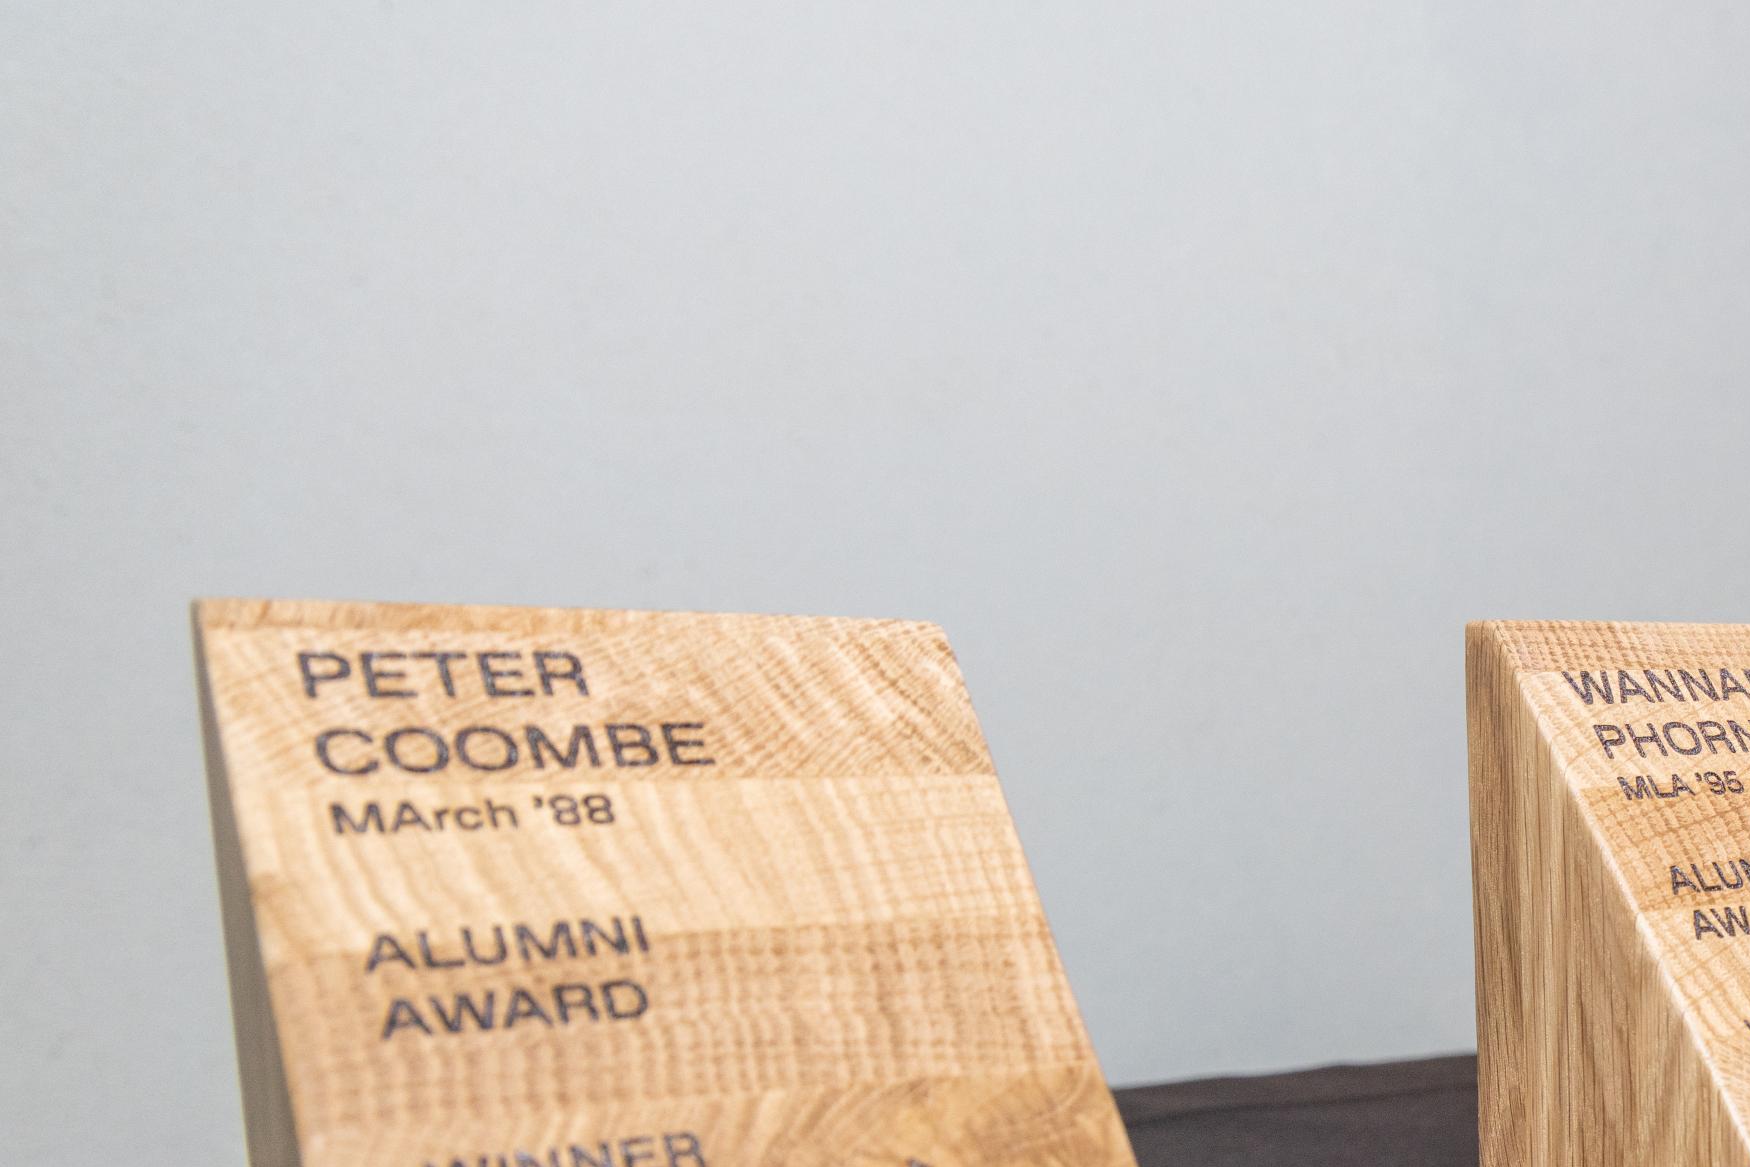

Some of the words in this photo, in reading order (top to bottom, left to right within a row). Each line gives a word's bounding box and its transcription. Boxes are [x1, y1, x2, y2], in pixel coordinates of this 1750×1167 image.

[296, 650, 590, 699] PETER
[314, 721, 717, 776] COOMBE
[1616, 773, 1695, 801] MLA
[1695, 769, 1746, 797] '95
[331, 797, 519, 836] MArch
[533, 793, 617, 826] '88
[365, 914, 651, 974] ALUMNI
[380, 979, 650, 1041] AWARD
